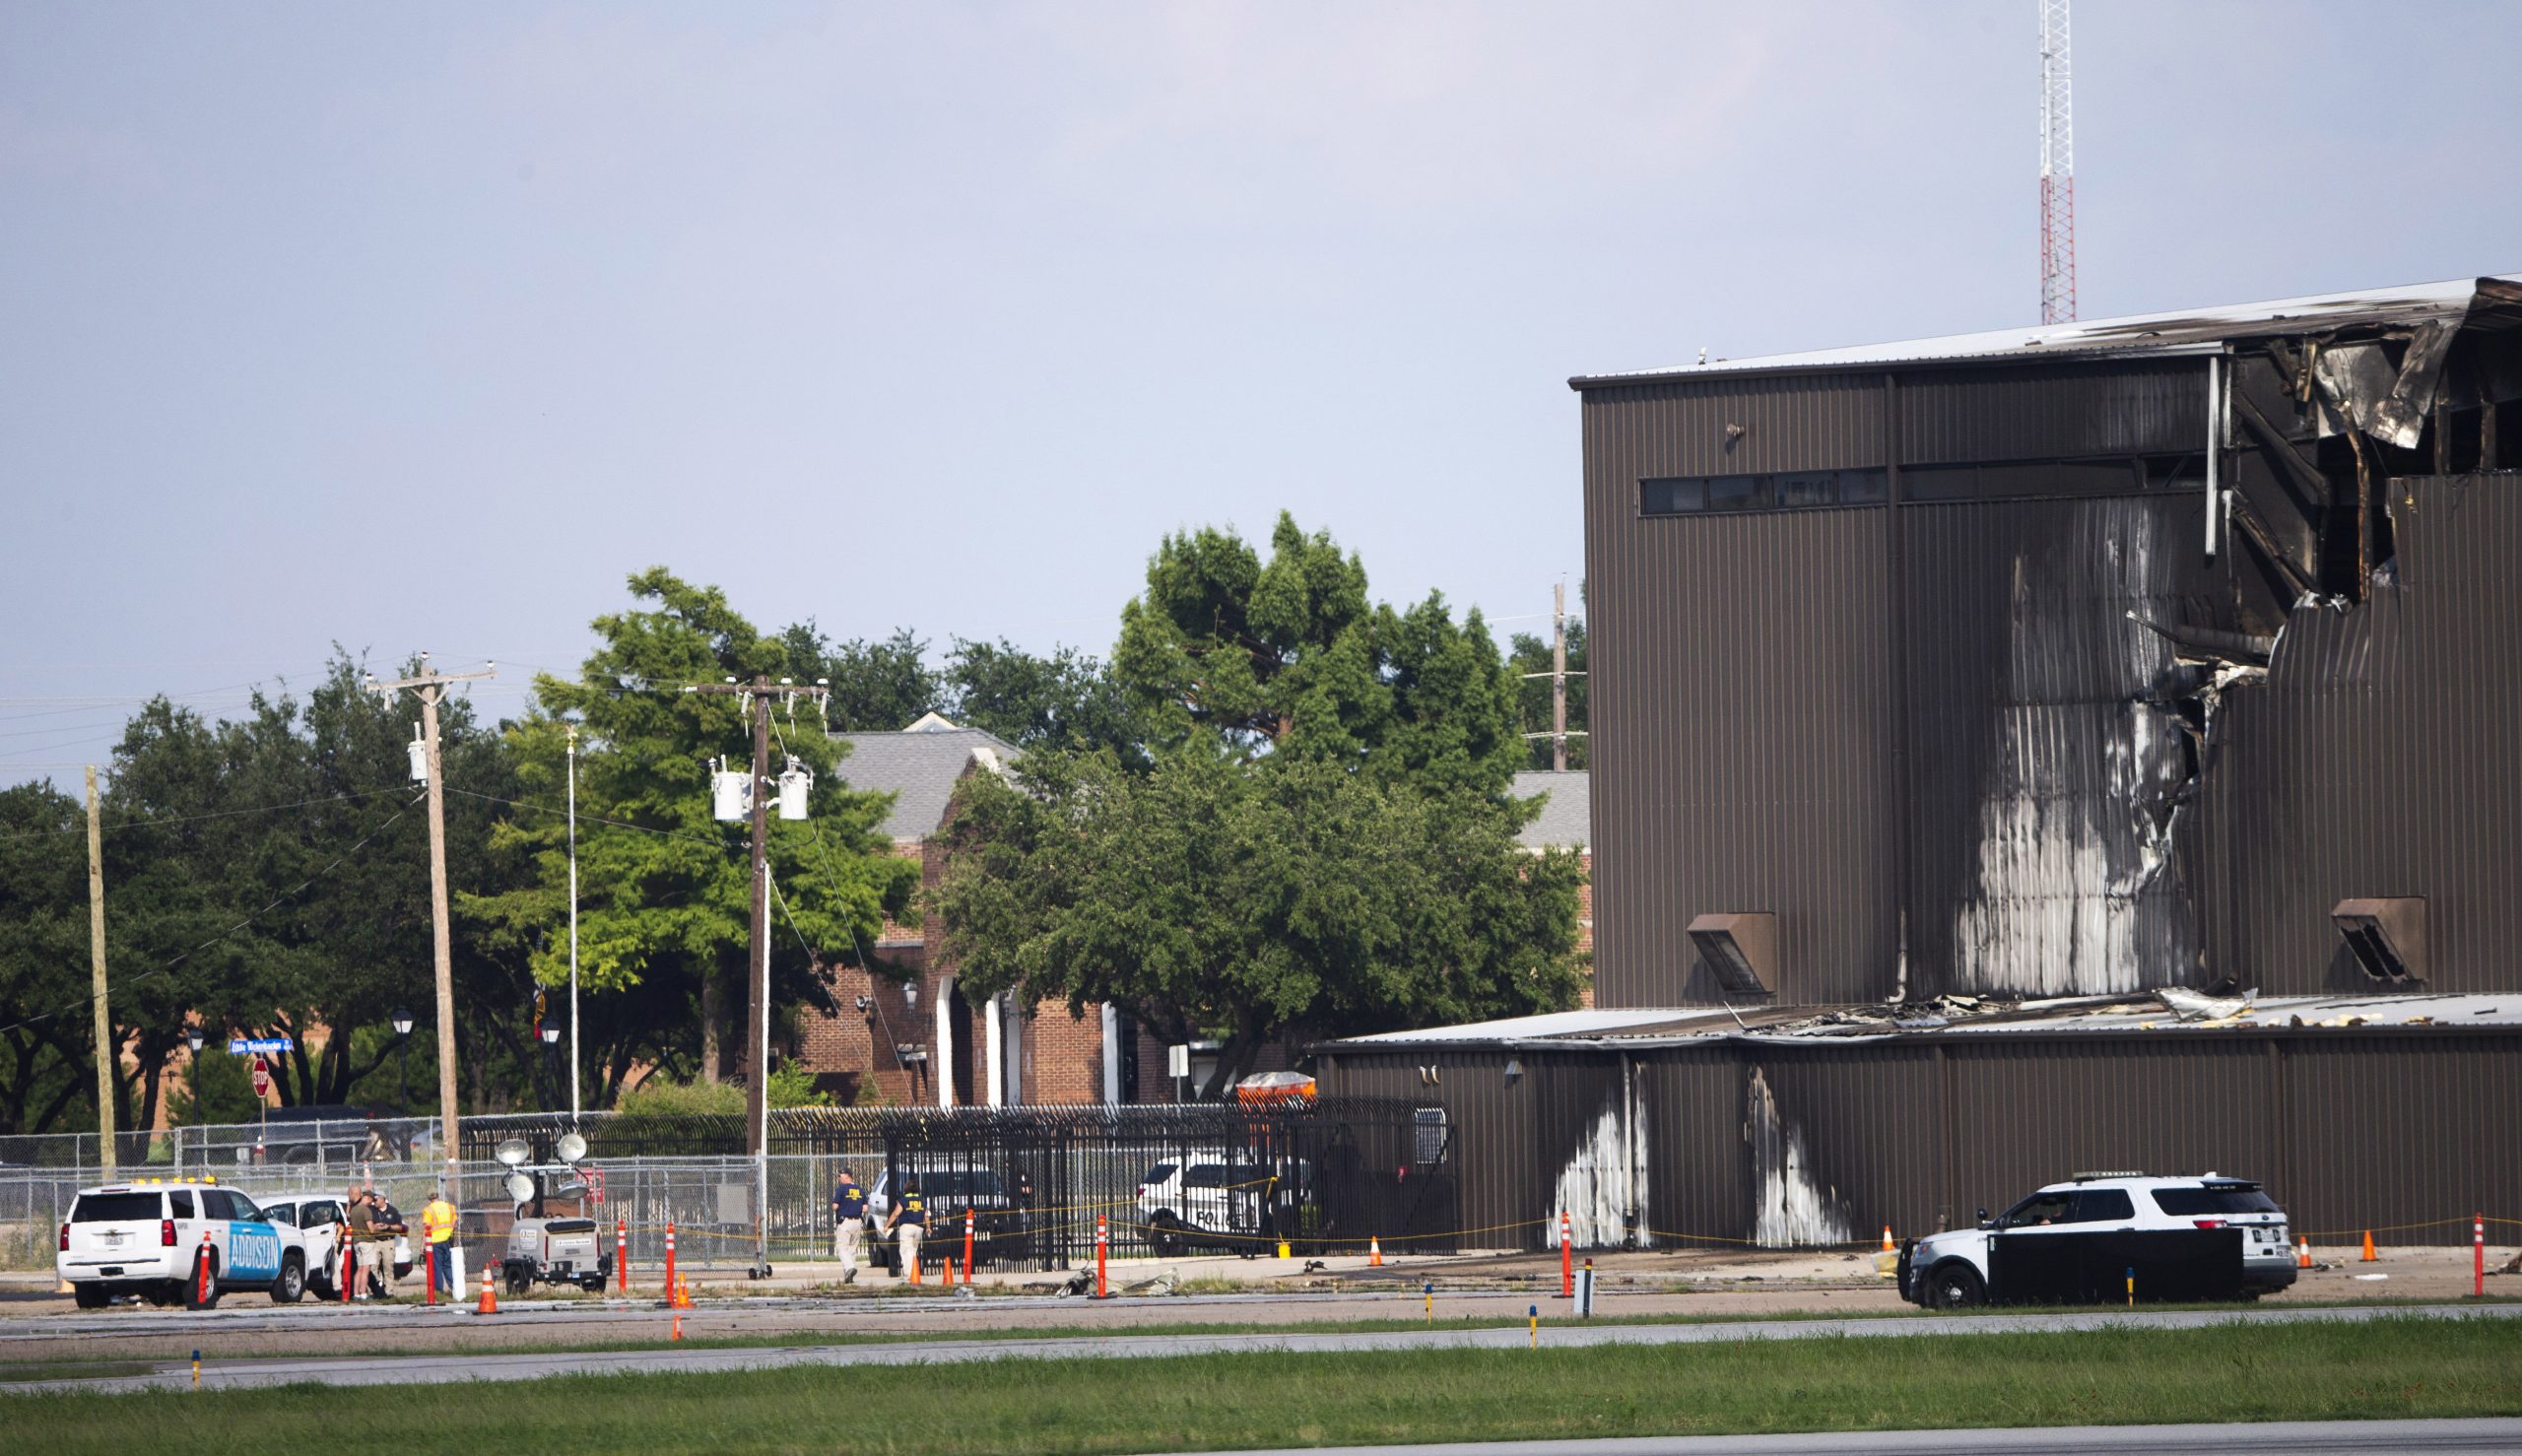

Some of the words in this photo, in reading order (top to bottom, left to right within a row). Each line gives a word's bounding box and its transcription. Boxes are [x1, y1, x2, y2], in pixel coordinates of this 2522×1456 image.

[253, 1071, 268, 1085] STOP
[848, 1188, 860, 1197] FBI
[909, 1200, 922, 1209] FBI
[231, 1234, 279, 1269] ADDISON
